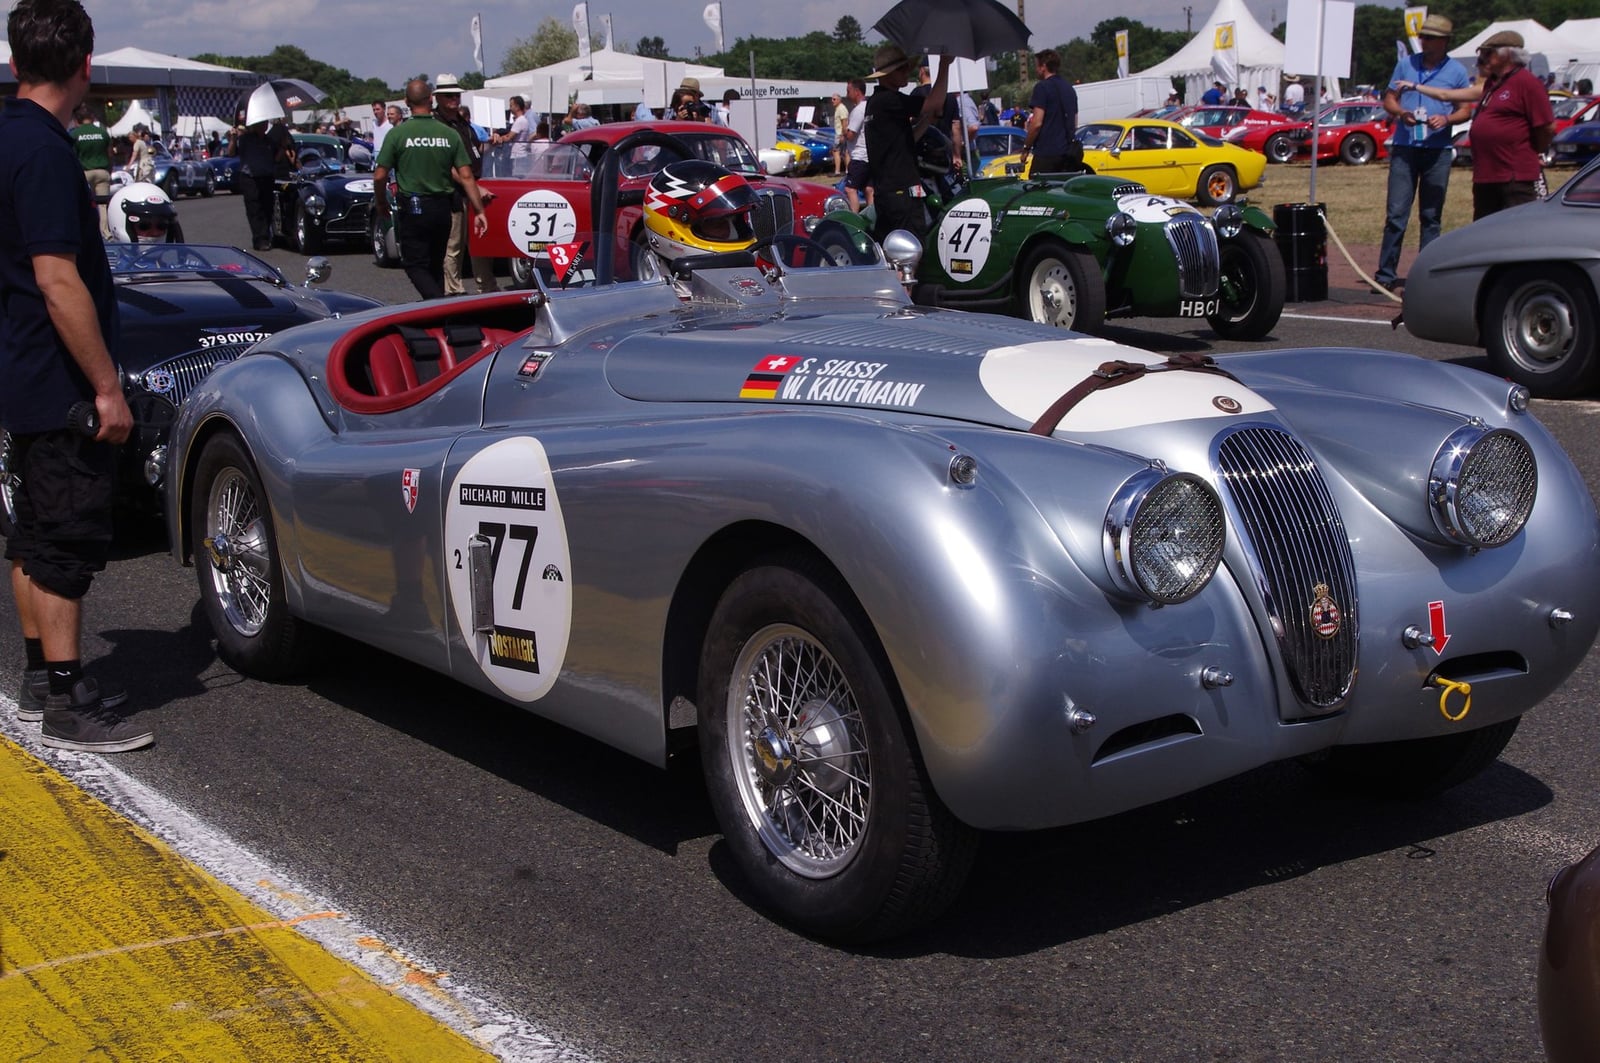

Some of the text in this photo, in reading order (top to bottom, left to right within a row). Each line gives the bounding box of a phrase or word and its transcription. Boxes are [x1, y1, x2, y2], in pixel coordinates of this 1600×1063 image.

[740, 85, 800, 97] Lounge Porsche
[78, 133, 103, 141] ACCUEIL
[405, 137, 451, 148] ACCUEIL
[524, 212, 558, 237] 31
[948, 223, 982, 254] 47
[551, 246, 570, 266] 3
[794, 357, 889, 380] S. SIASSI
[781, 375, 926, 407] W. KAUFMANN
[461, 487, 544, 507] RICHARD MILLE
[454, 548, 463, 570] 2
[478, 520, 539, 611] 77
[489, 629, 536, 663] NOSTALGIE
